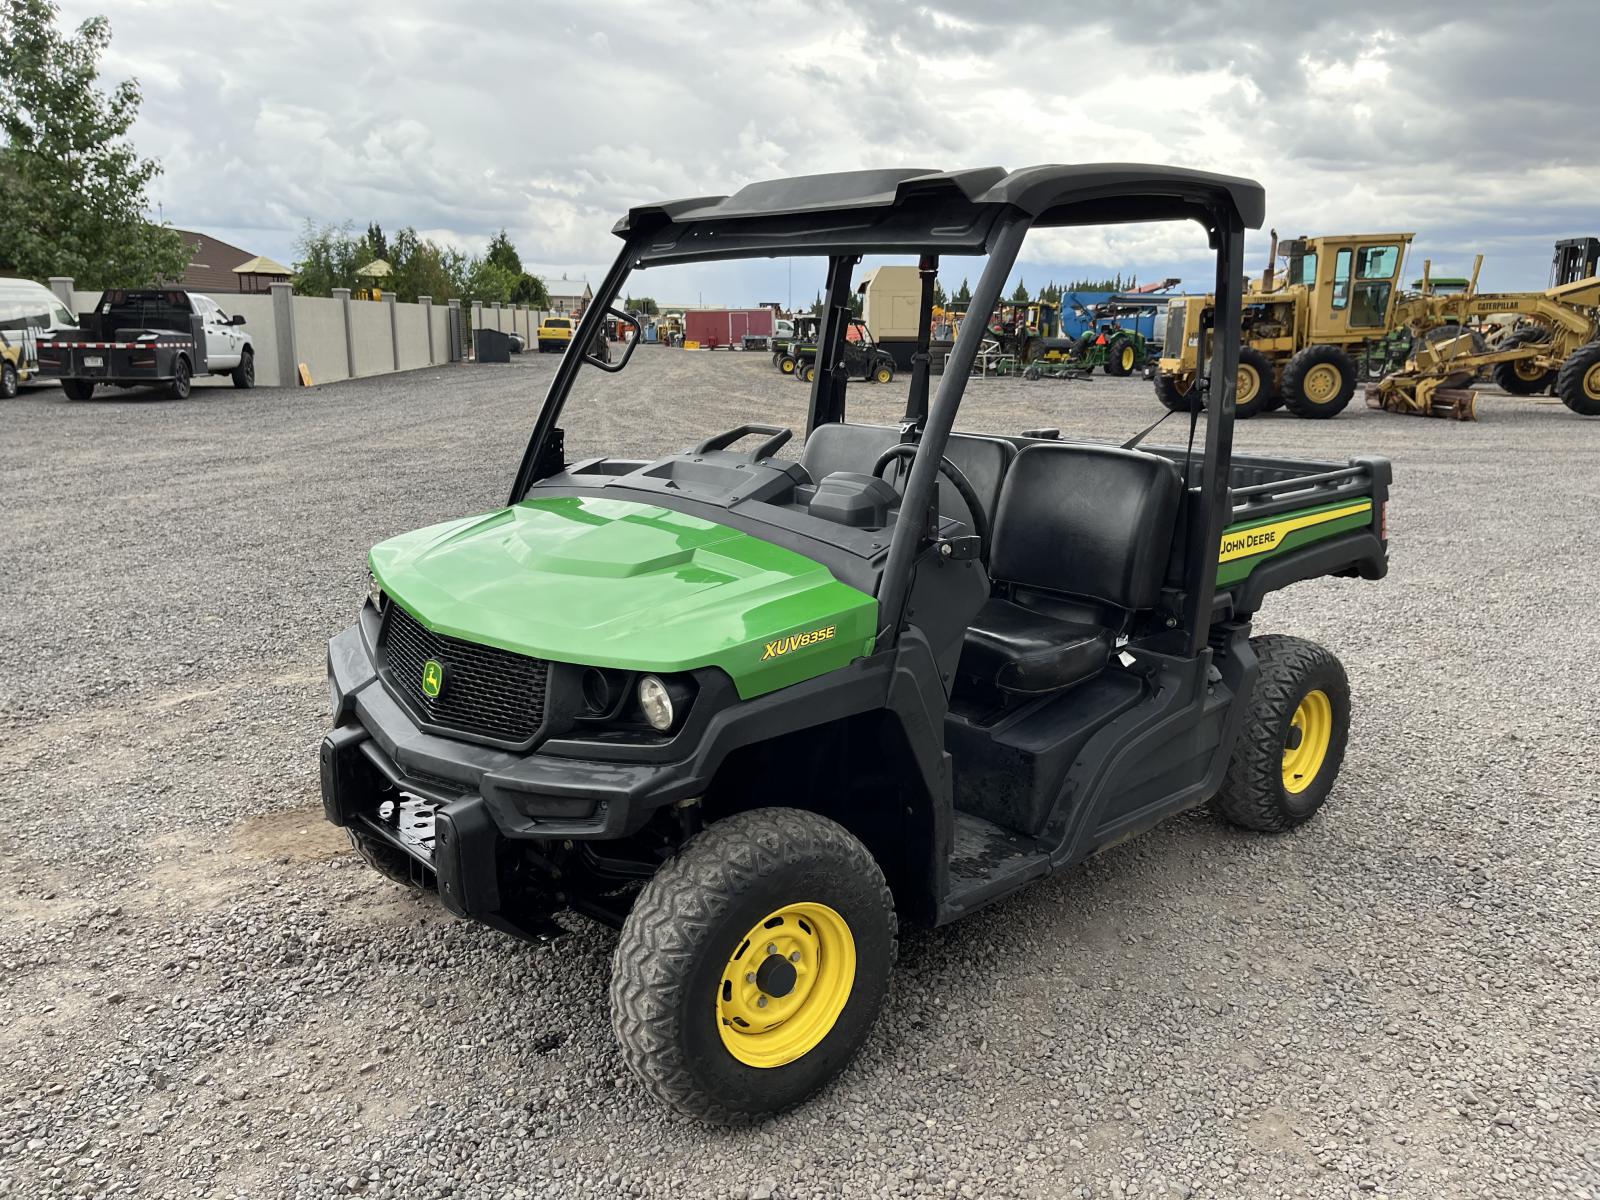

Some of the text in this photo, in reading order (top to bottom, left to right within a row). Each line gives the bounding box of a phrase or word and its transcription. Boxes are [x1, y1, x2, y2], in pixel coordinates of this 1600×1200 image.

[1477, 301, 1519, 311] CATERPILLAR
[1220, 531, 1276, 555] JOHN DEERE
[762, 626, 835, 660] XUV835E
